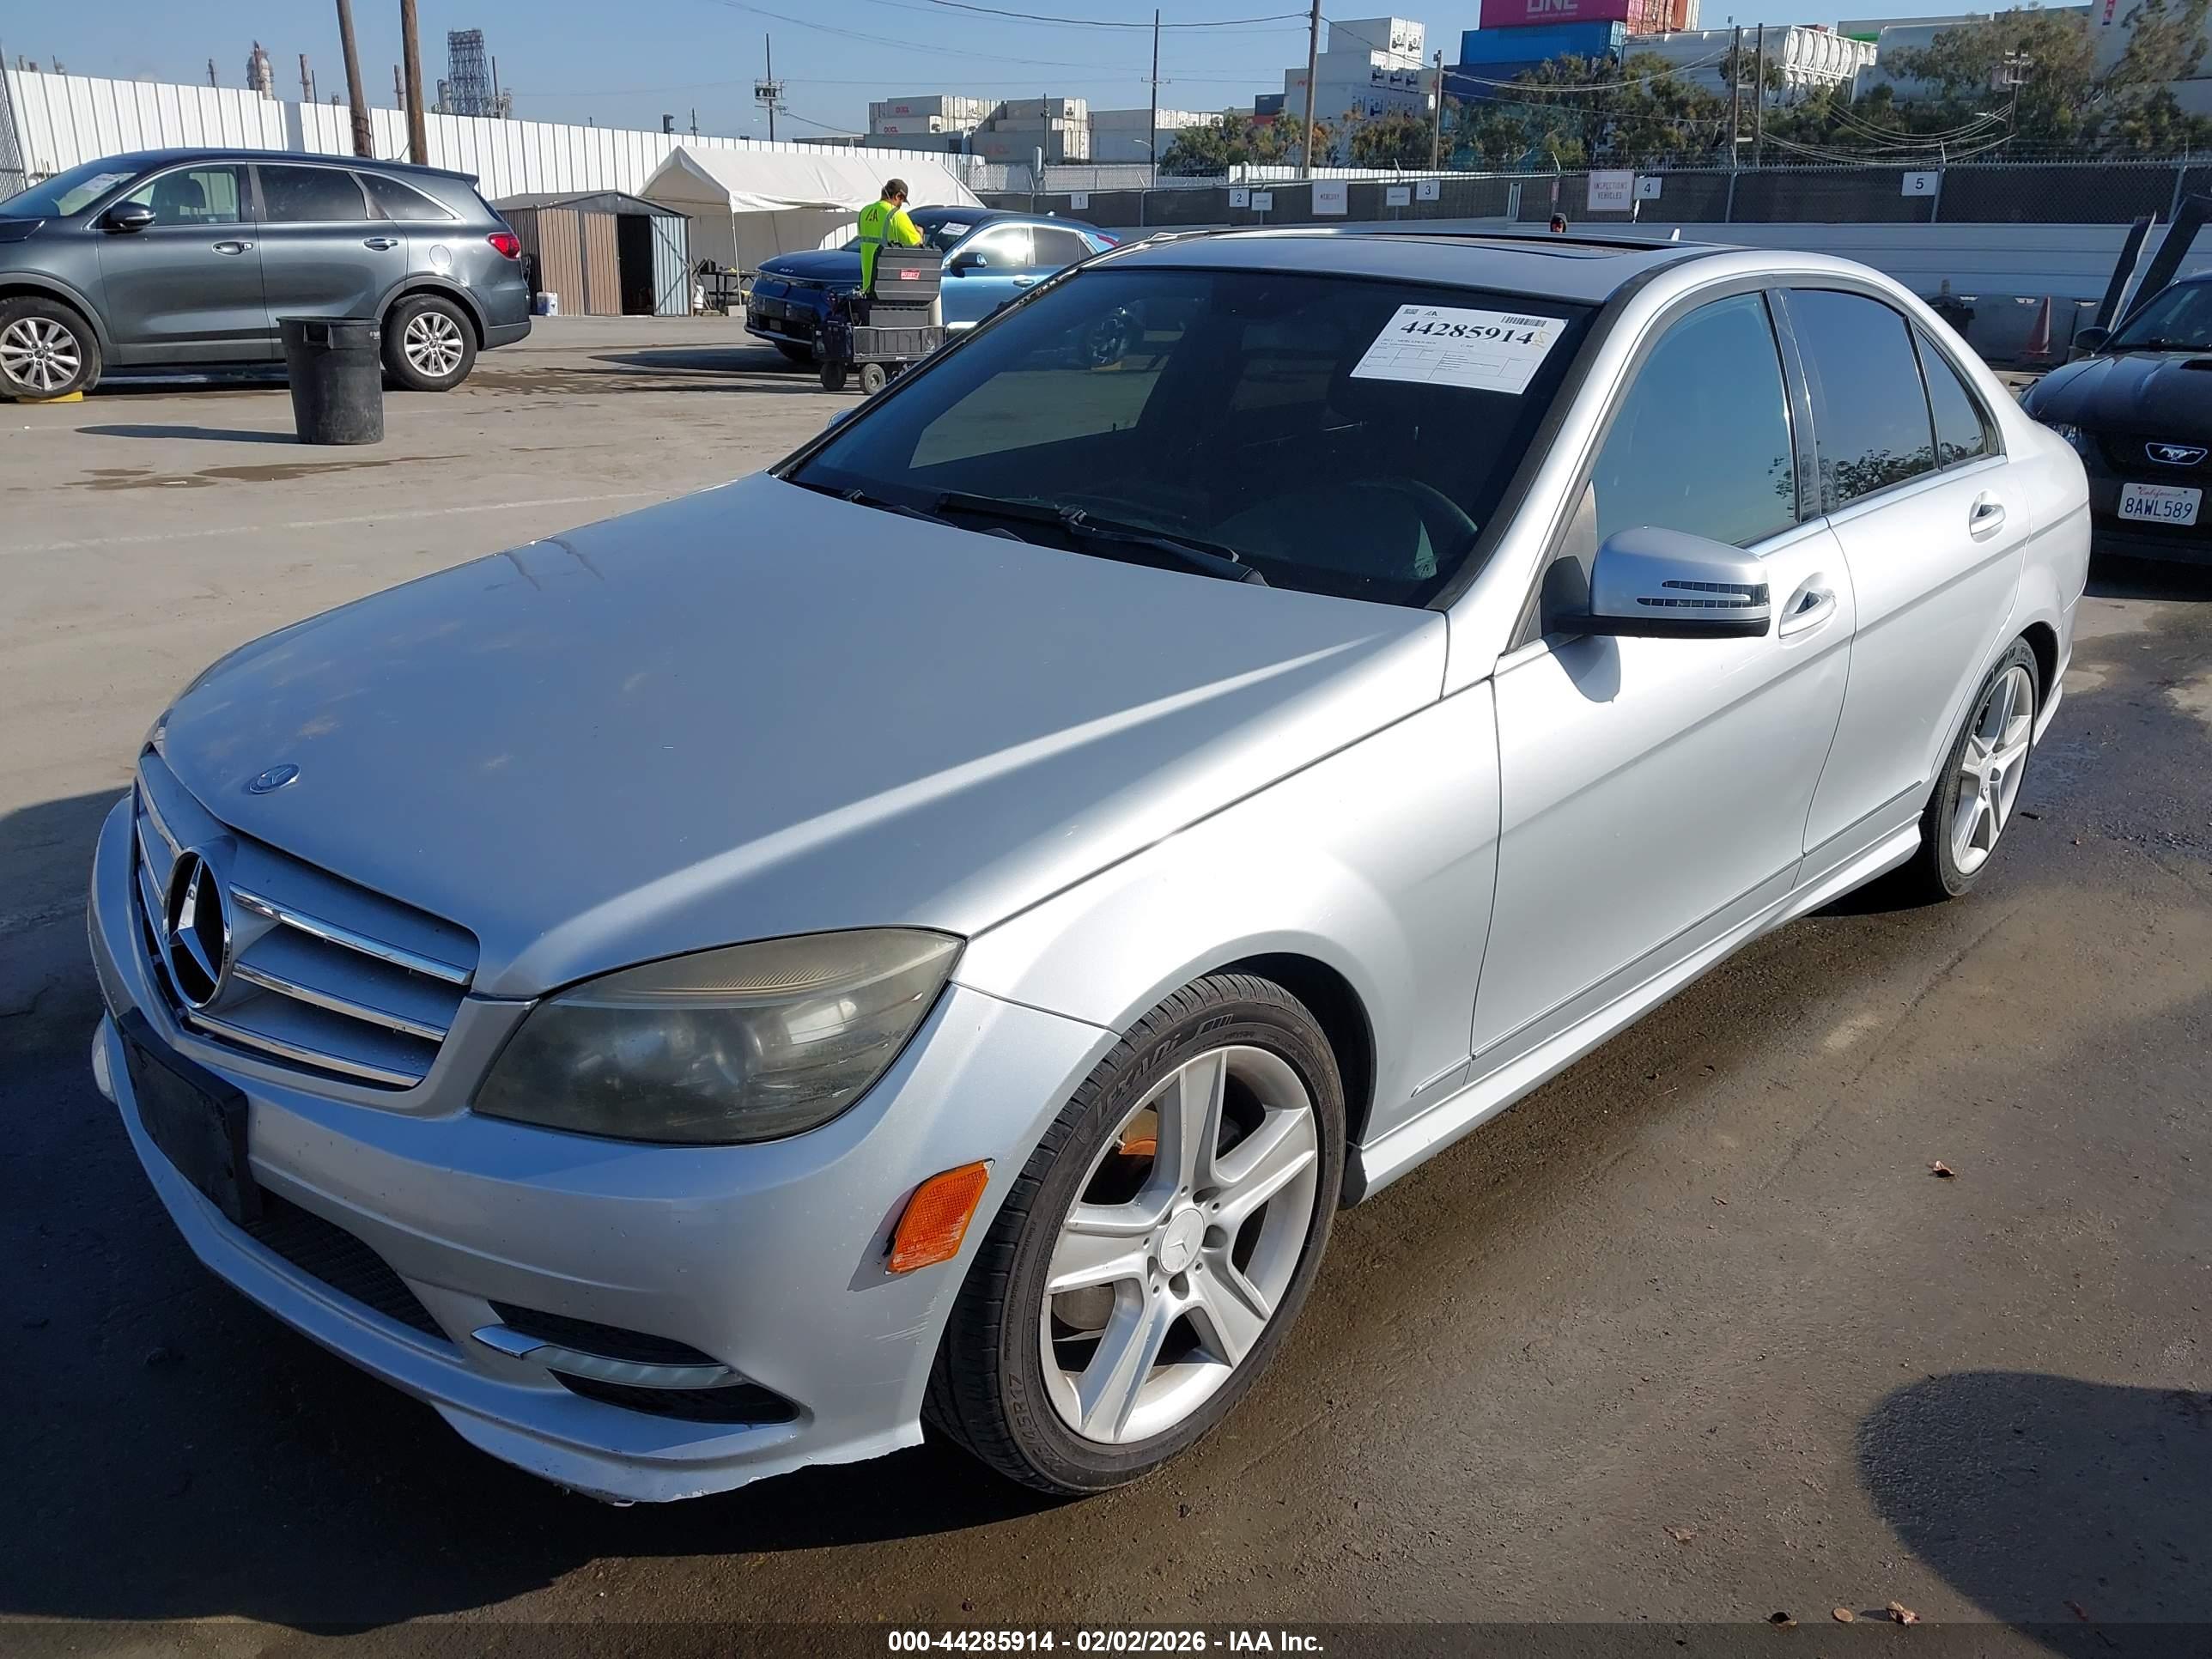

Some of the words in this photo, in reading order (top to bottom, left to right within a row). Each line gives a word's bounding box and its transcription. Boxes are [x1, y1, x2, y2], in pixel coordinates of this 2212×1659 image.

[1644, 183, 1651, 193] 4
[1915, 177, 1924, 190] 5
[1425, 185, 1431, 196] 3
[1237, 193, 1243, 203] 2
[1401, 320, 1534, 345] 44285914
[2124, 497, 2193, 520] 8AWL589
